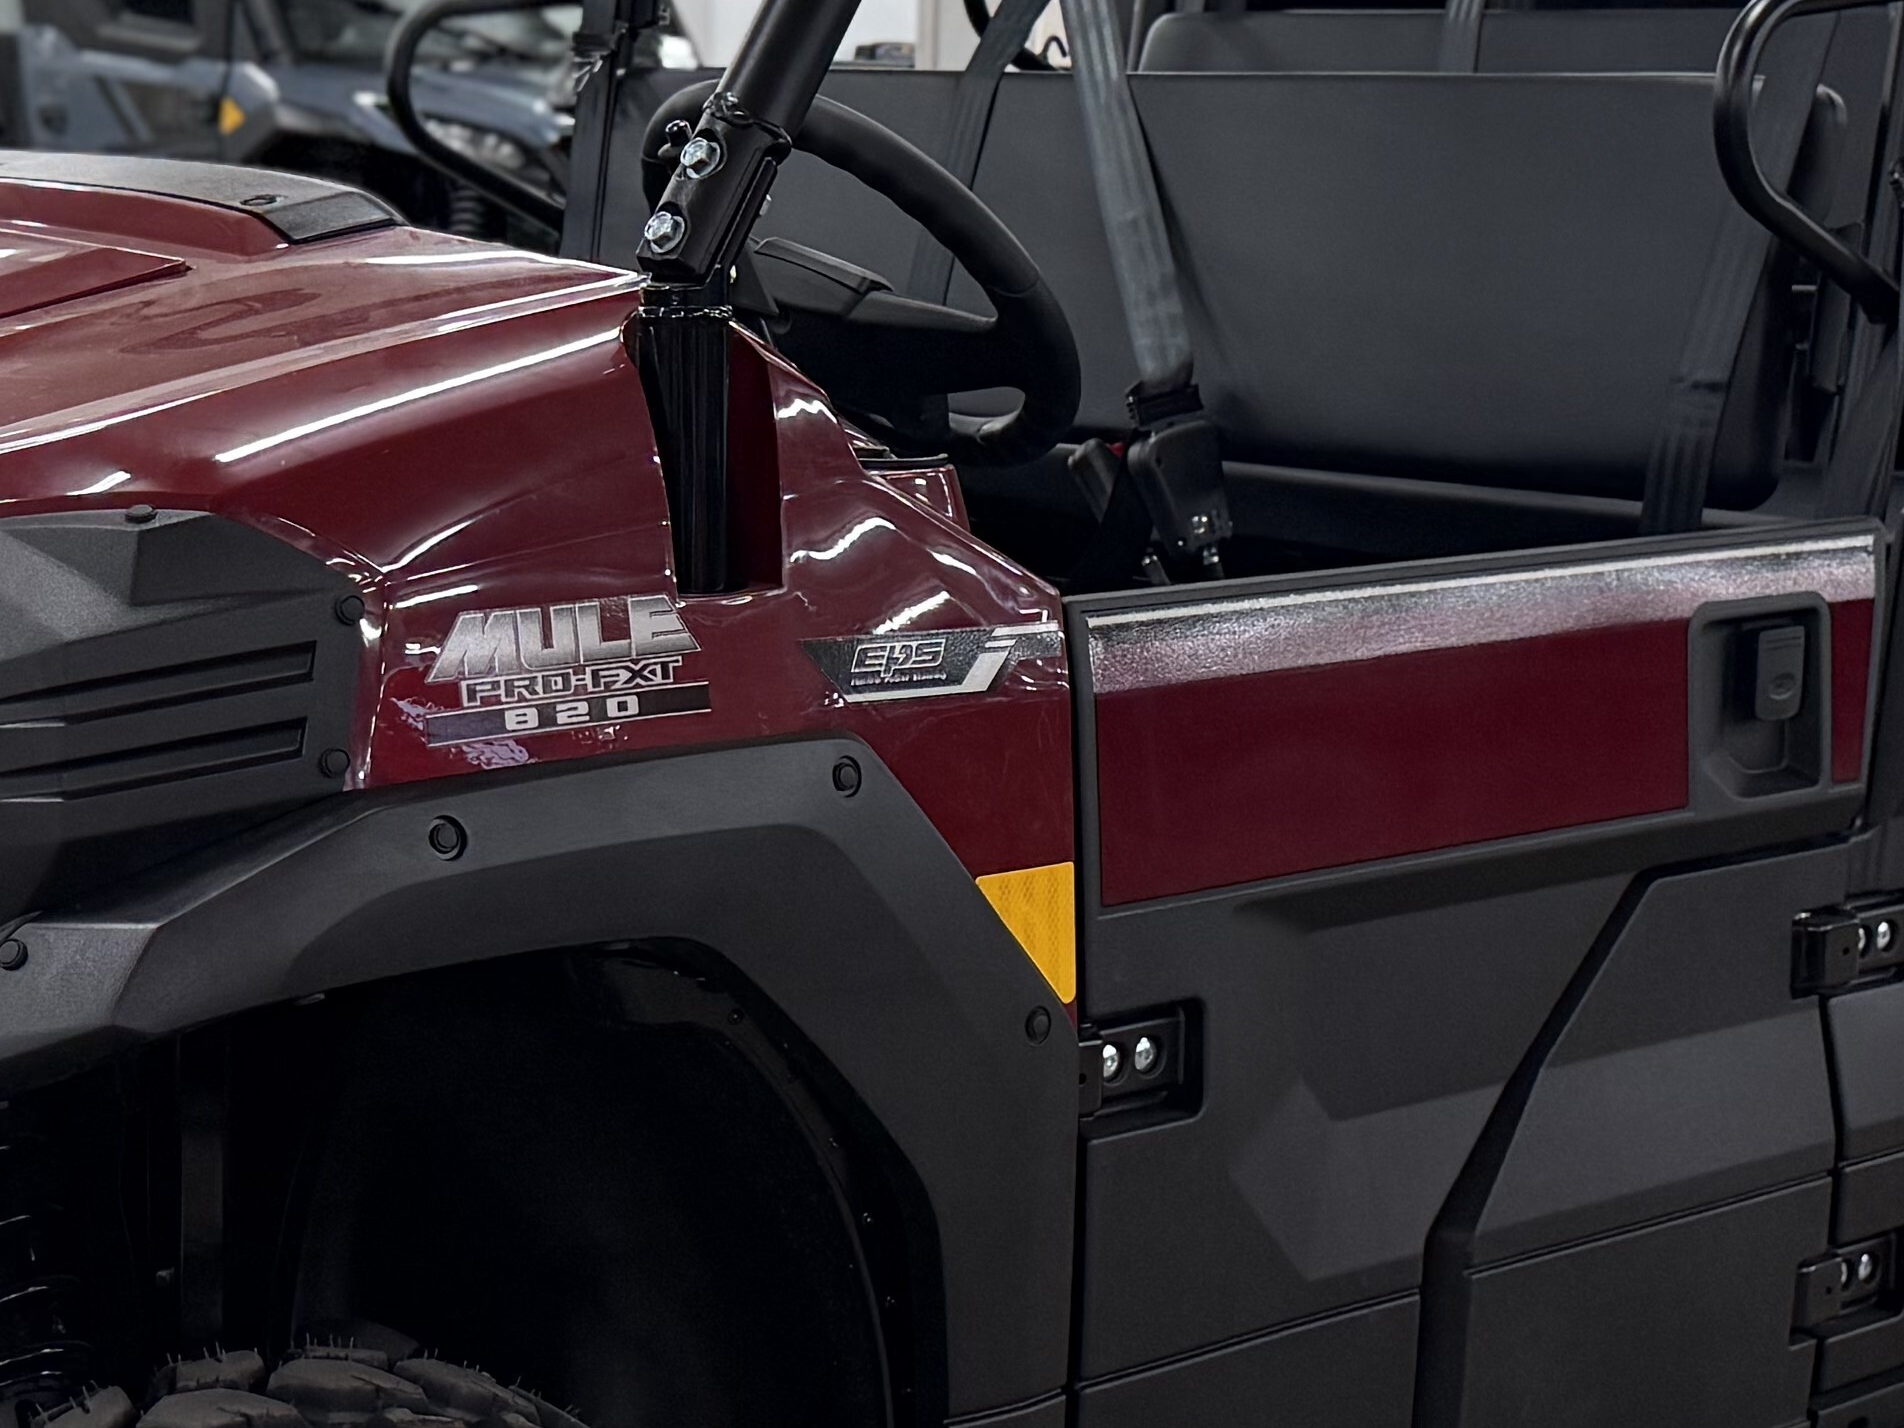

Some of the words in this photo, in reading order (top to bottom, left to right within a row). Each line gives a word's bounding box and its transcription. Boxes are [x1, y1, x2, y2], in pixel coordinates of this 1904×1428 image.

[424, 592, 703, 683] MULE
[851, 638, 946, 678] EPS
[461, 656, 682, 708] PRO-FXT
